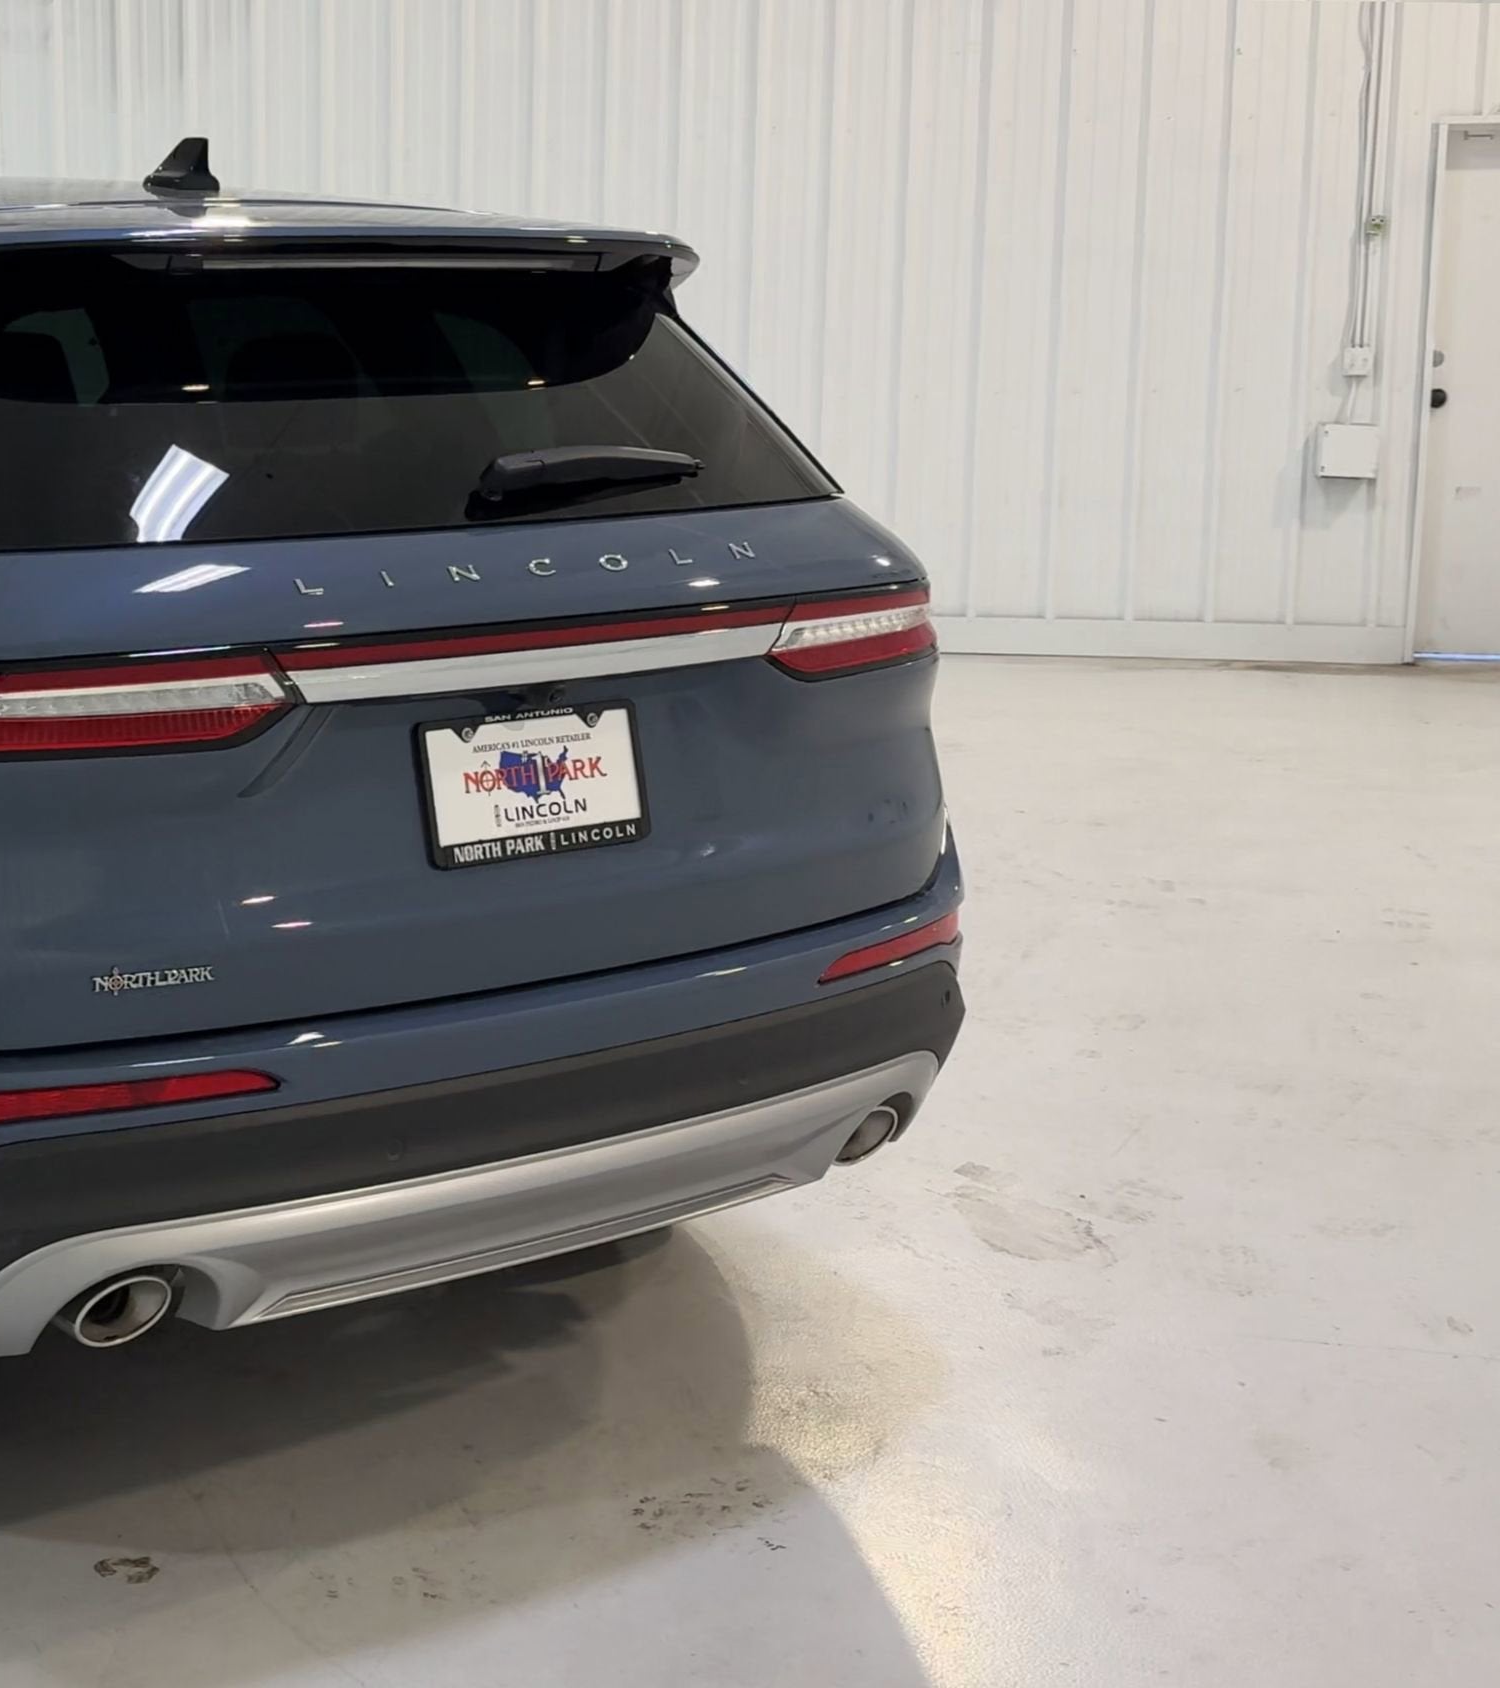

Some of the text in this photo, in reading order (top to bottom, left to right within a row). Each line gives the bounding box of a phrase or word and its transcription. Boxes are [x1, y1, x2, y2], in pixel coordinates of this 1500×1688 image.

[293, 540, 756, 596] LINCOLN
[484, 706, 574, 723] SAN ANTONIO
[472, 743, 511, 754] AMERICA'S
[520, 737, 555, 748] LINCOLN
[555, 732, 592, 744] RETAILER
[463, 756, 608, 794] NORTH PARK
[504, 798, 588, 823] LINCOLN
[453, 823, 637, 864] NORTH PARK LINCOLN
